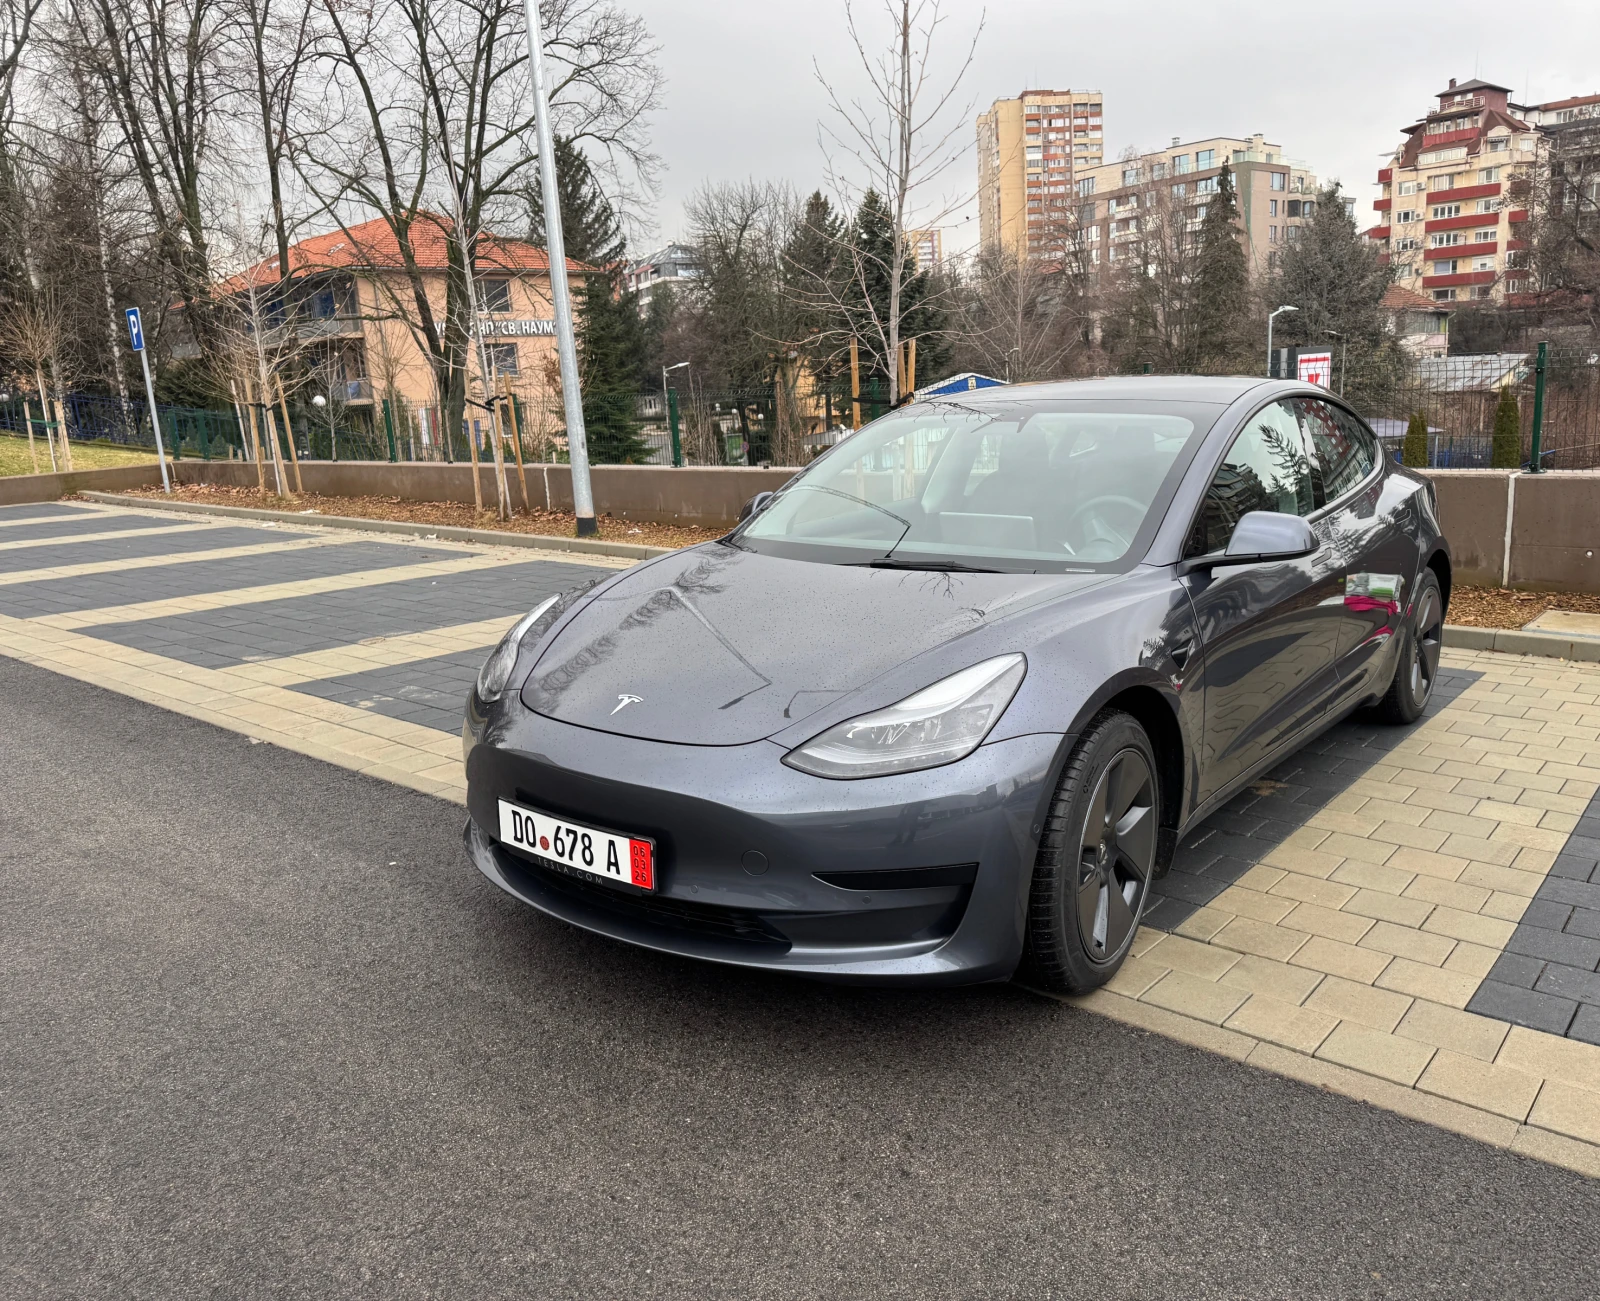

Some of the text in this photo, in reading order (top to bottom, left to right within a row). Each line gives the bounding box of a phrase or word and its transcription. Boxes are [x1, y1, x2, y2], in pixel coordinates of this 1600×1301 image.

[129, 314, 138, 346] P
[512, 810, 621, 875] DO 678 A
[633, 845, 646, 857] 06
[538, 856, 603, 885] TESLA.COM
[634, 857, 646, 870] 03
[635, 870, 647, 882] 26
